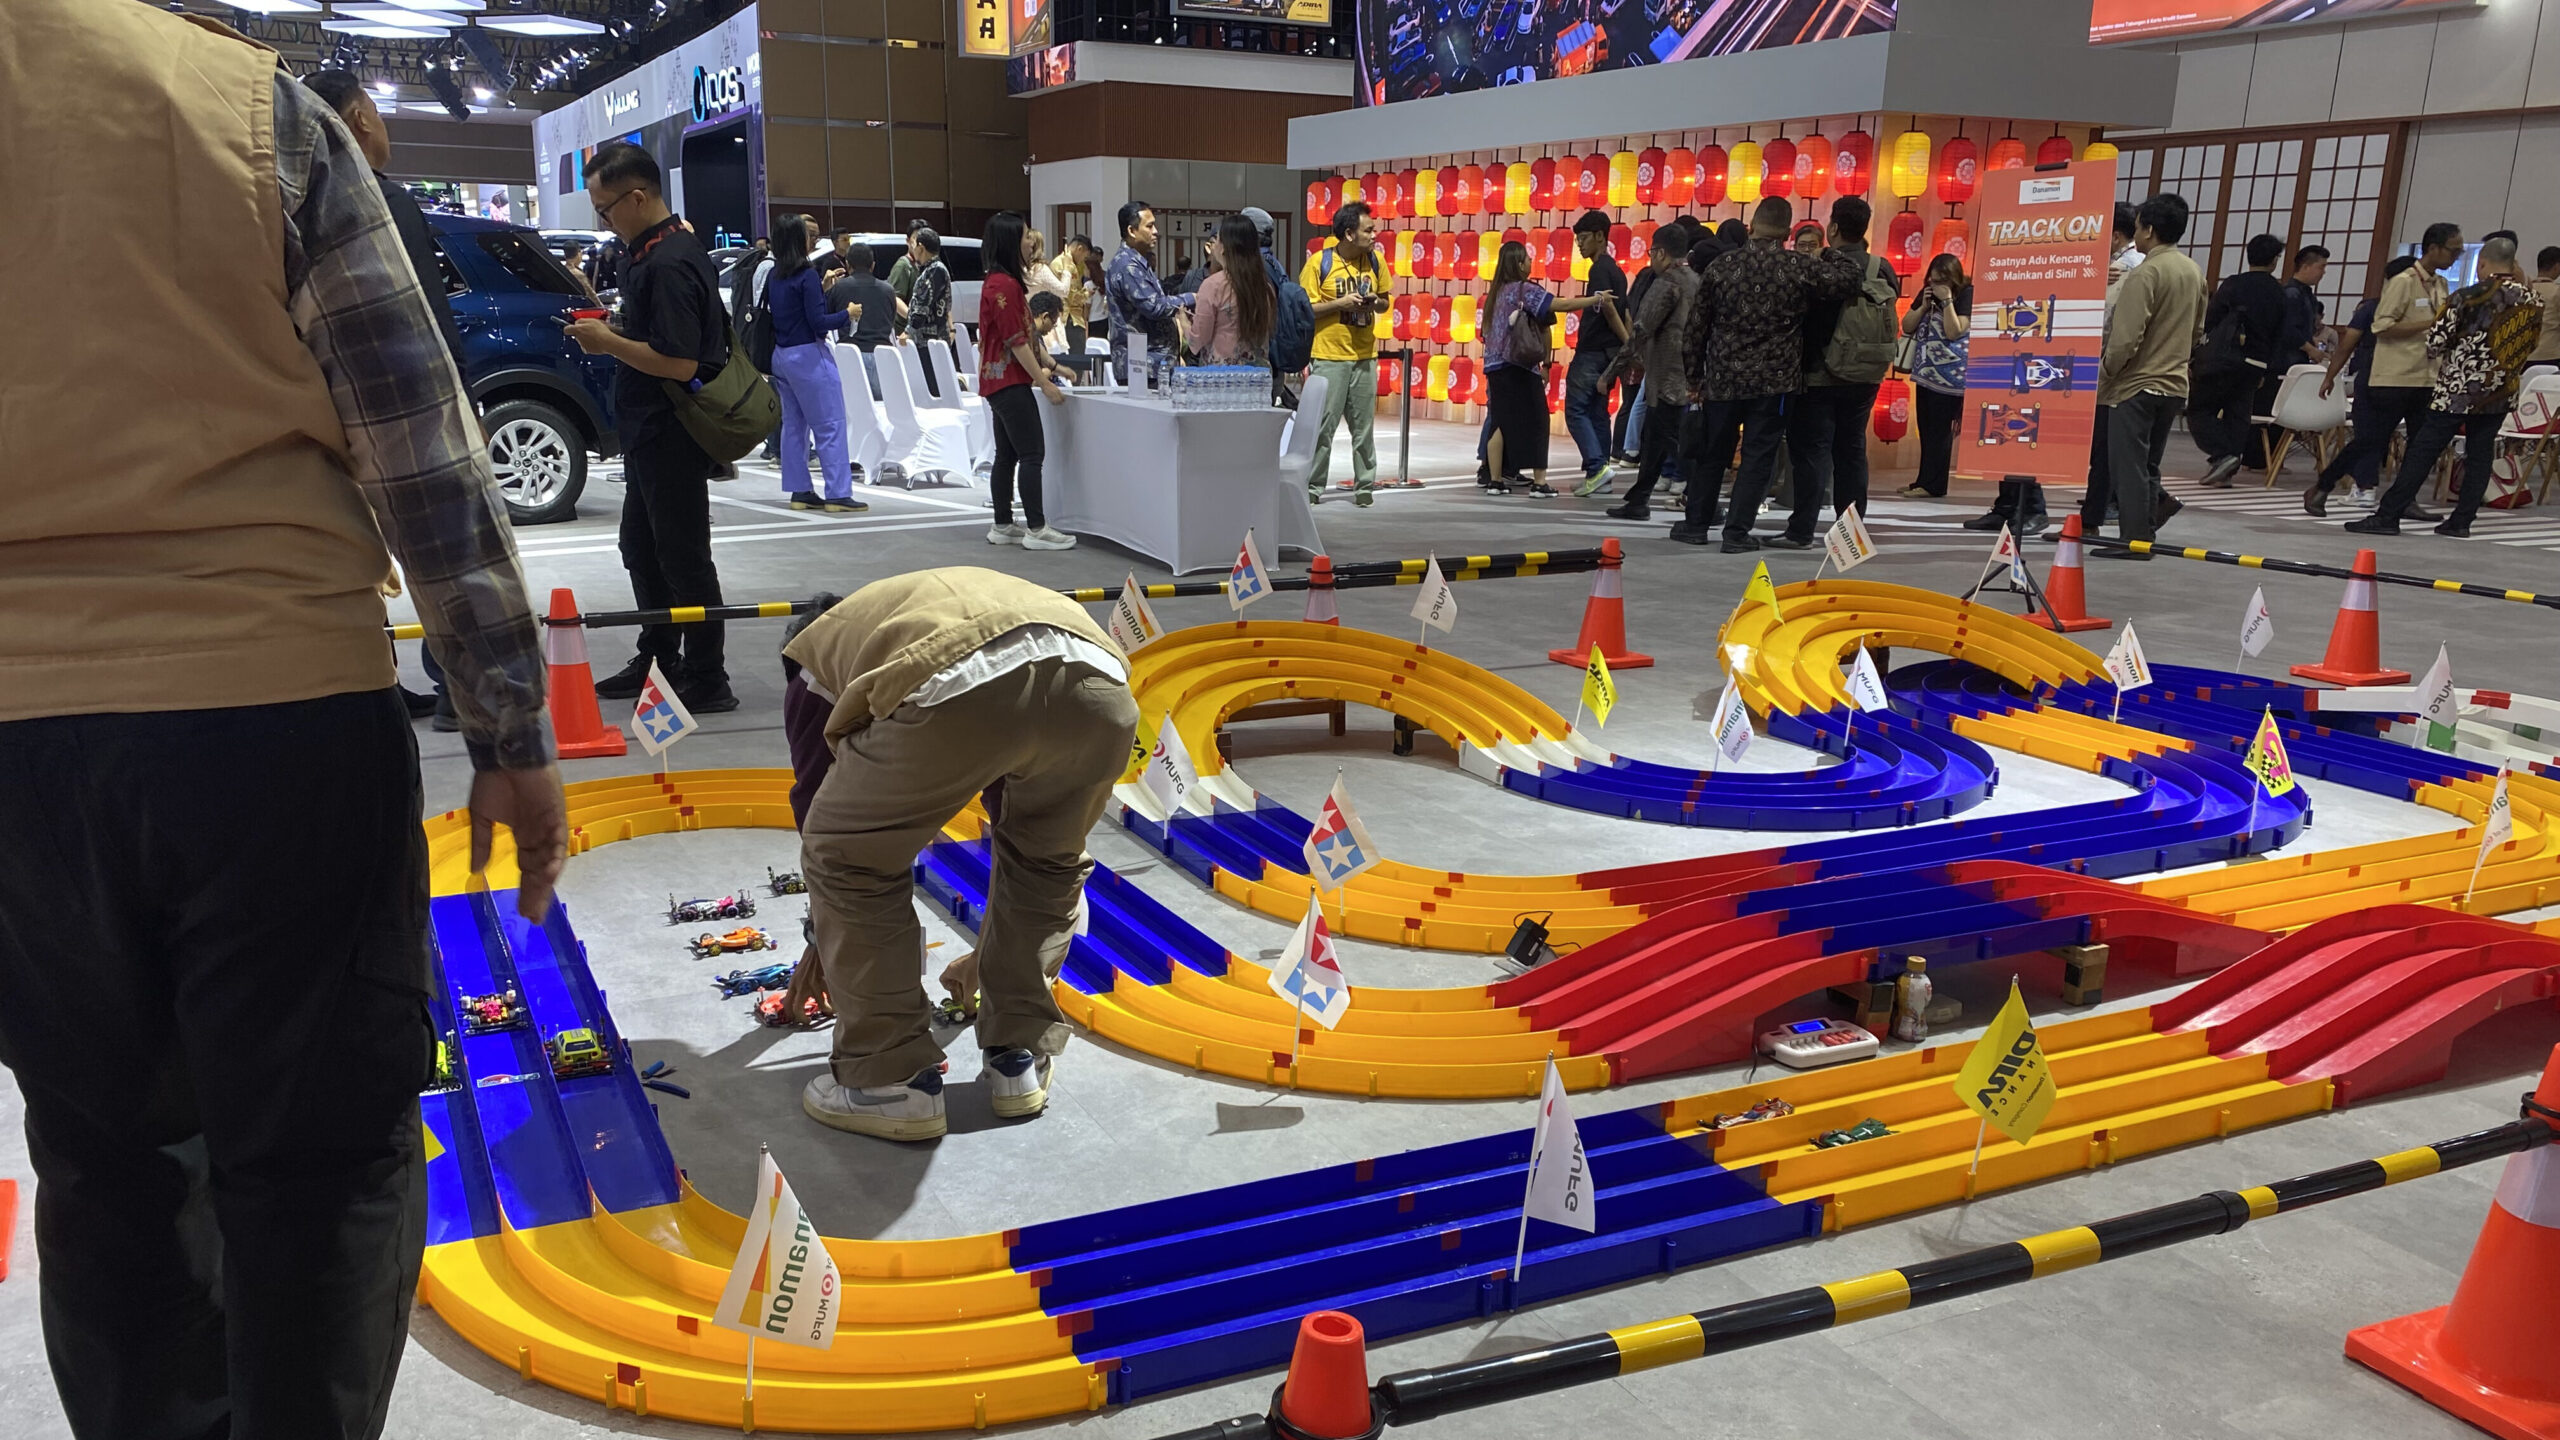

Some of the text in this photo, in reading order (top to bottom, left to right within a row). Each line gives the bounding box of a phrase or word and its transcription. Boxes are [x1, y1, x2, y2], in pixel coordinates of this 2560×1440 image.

[704, 65, 741, 113] IQOS
[2032, 186, 2061, 194] Danamon
[1988, 214, 2104, 244] TRACK ON
[1989, 254, 2094, 268] Saatnya Adu Kencang,
[2003, 268, 2077, 281] Mainkan di Sini!
[1837, 520, 1861, 560] anamon
[1118, 596, 1146, 643] anamon
[1857, 672, 1879, 704] MUFG
[1160, 755, 1185, 795] MUFG
